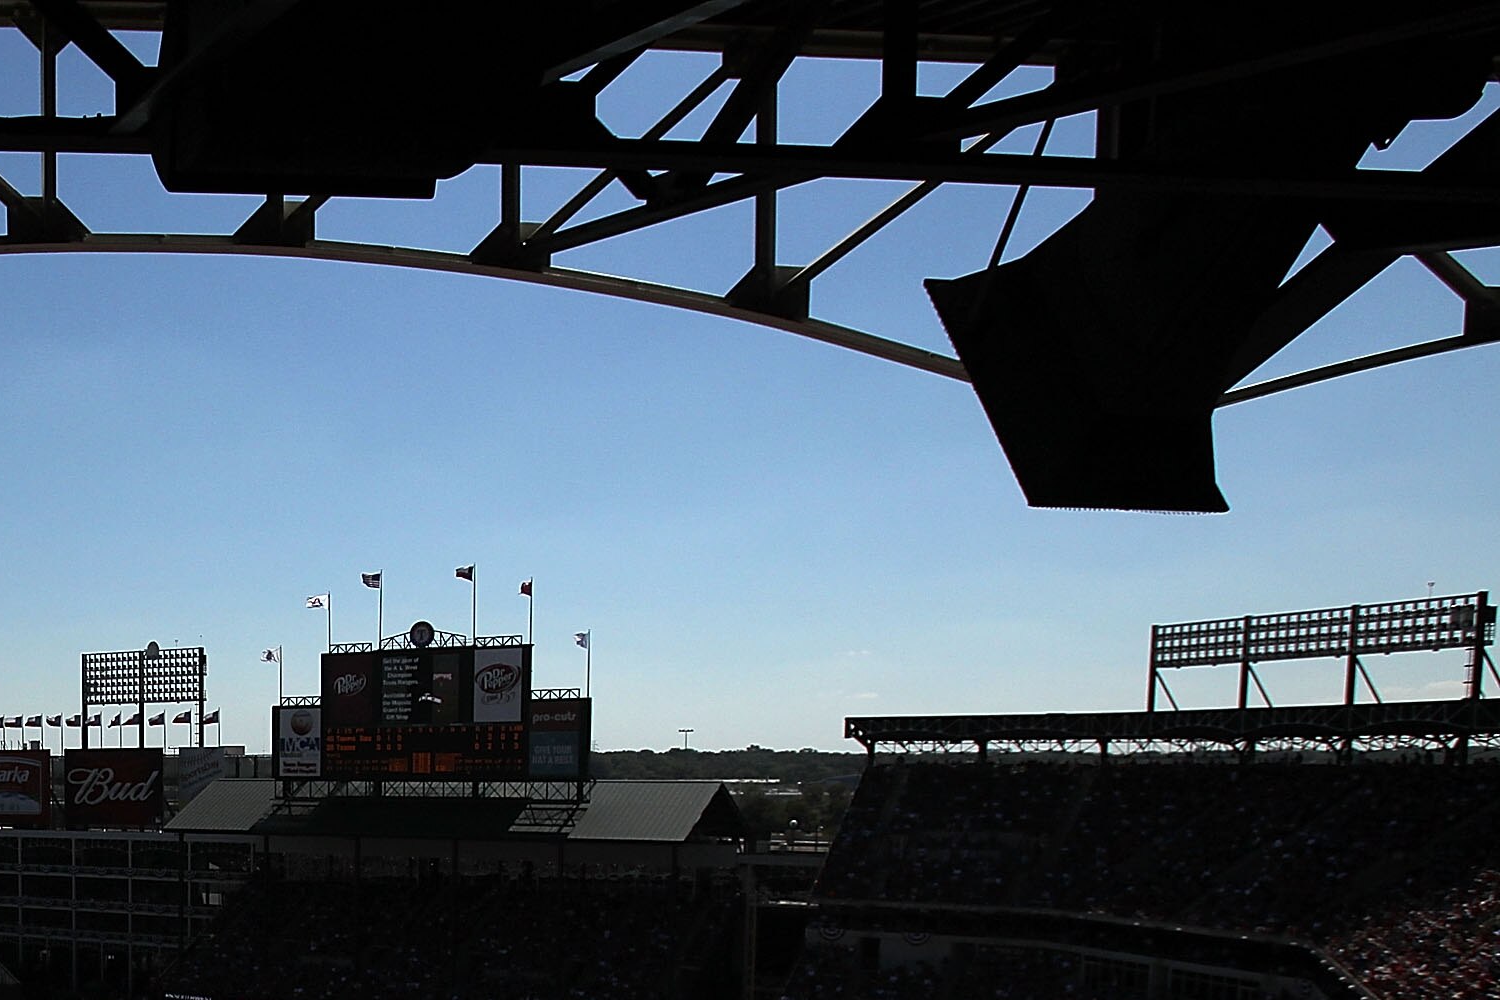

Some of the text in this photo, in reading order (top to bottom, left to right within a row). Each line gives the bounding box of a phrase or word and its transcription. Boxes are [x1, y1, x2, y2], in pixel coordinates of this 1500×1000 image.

[334, 676, 368, 695] Pepper
[478, 668, 519, 690] Pepper
[532, 711, 577, 725] pro-cuts
[67, 767, 161, 806] Bud
